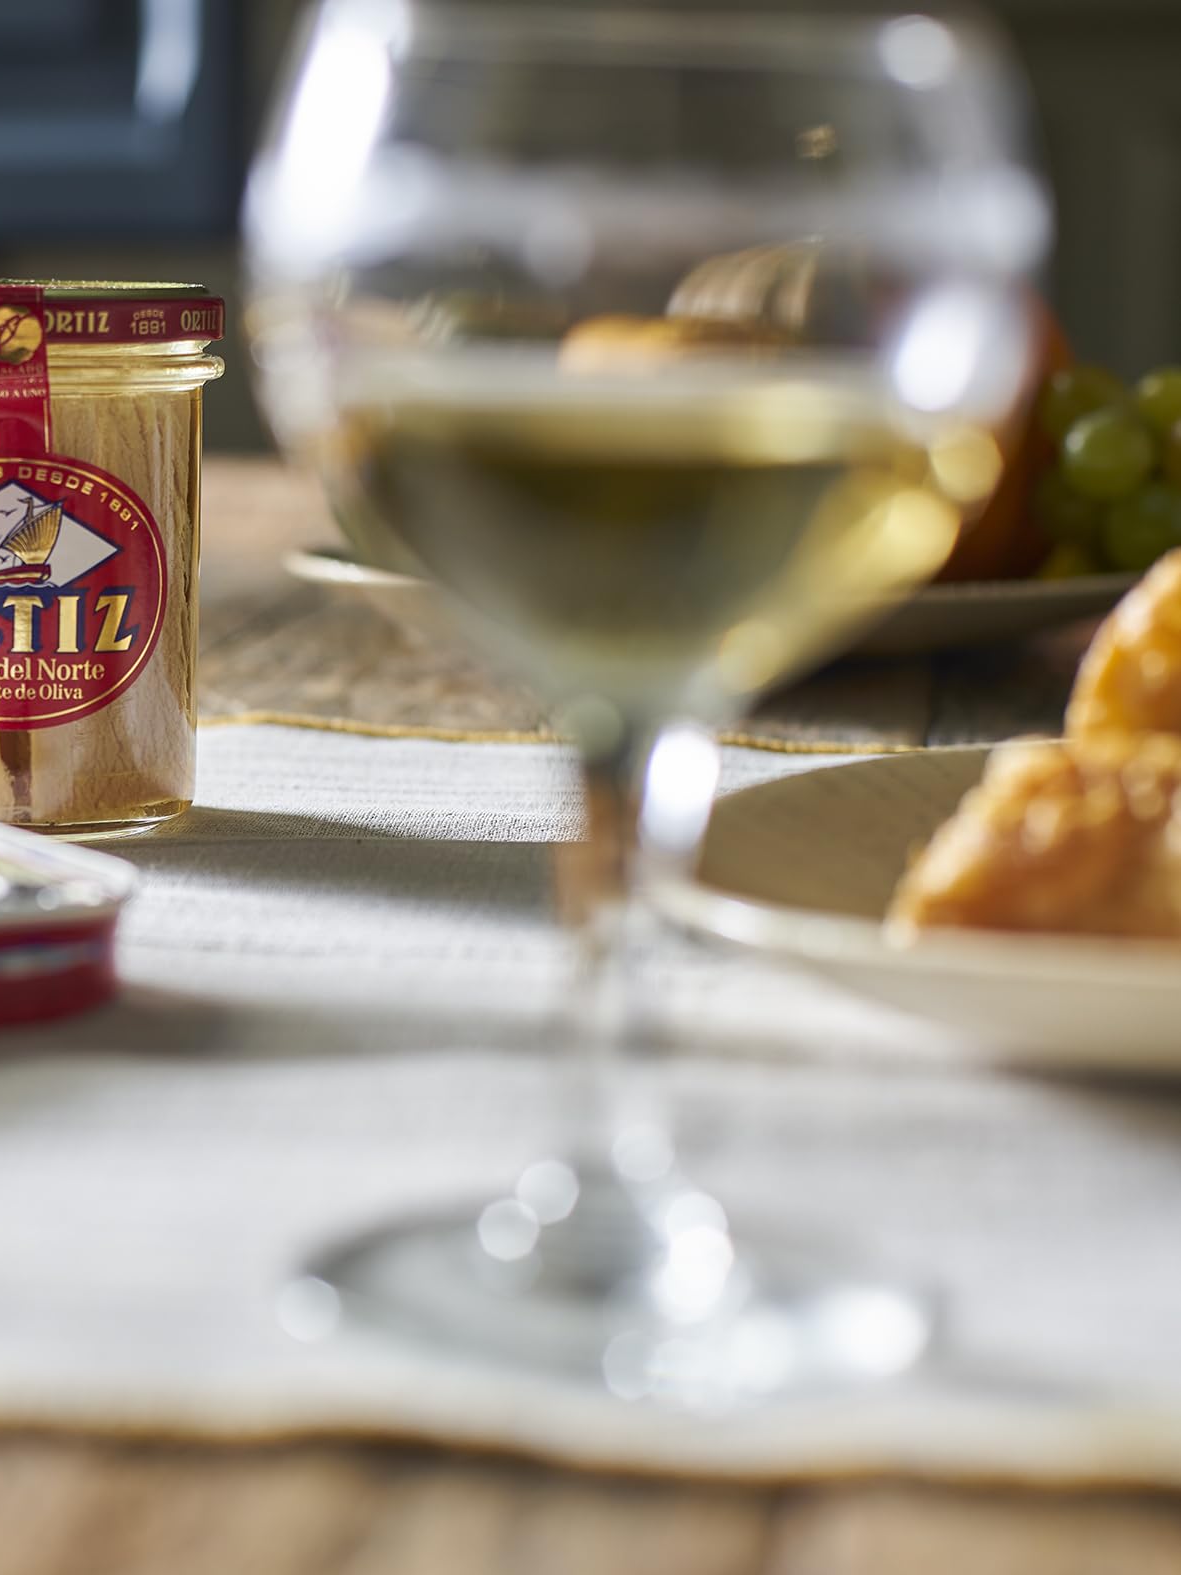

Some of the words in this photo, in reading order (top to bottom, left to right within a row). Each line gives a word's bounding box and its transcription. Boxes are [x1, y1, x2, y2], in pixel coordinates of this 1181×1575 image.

[132, 308, 164, 320] DESDE
[180, 309, 217, 332] ORTIZ
[129, 320, 167, 335] 1891
[12, 389, 21, 398] A
[22, 388, 47, 398] UNO
[18, 466, 94, 496] DESDE
[99, 491, 140, 532] 1891
[37, 657, 105, 682] Norte
[14, 682, 36, 699] de
[38, 682, 84, 700] Oliva
